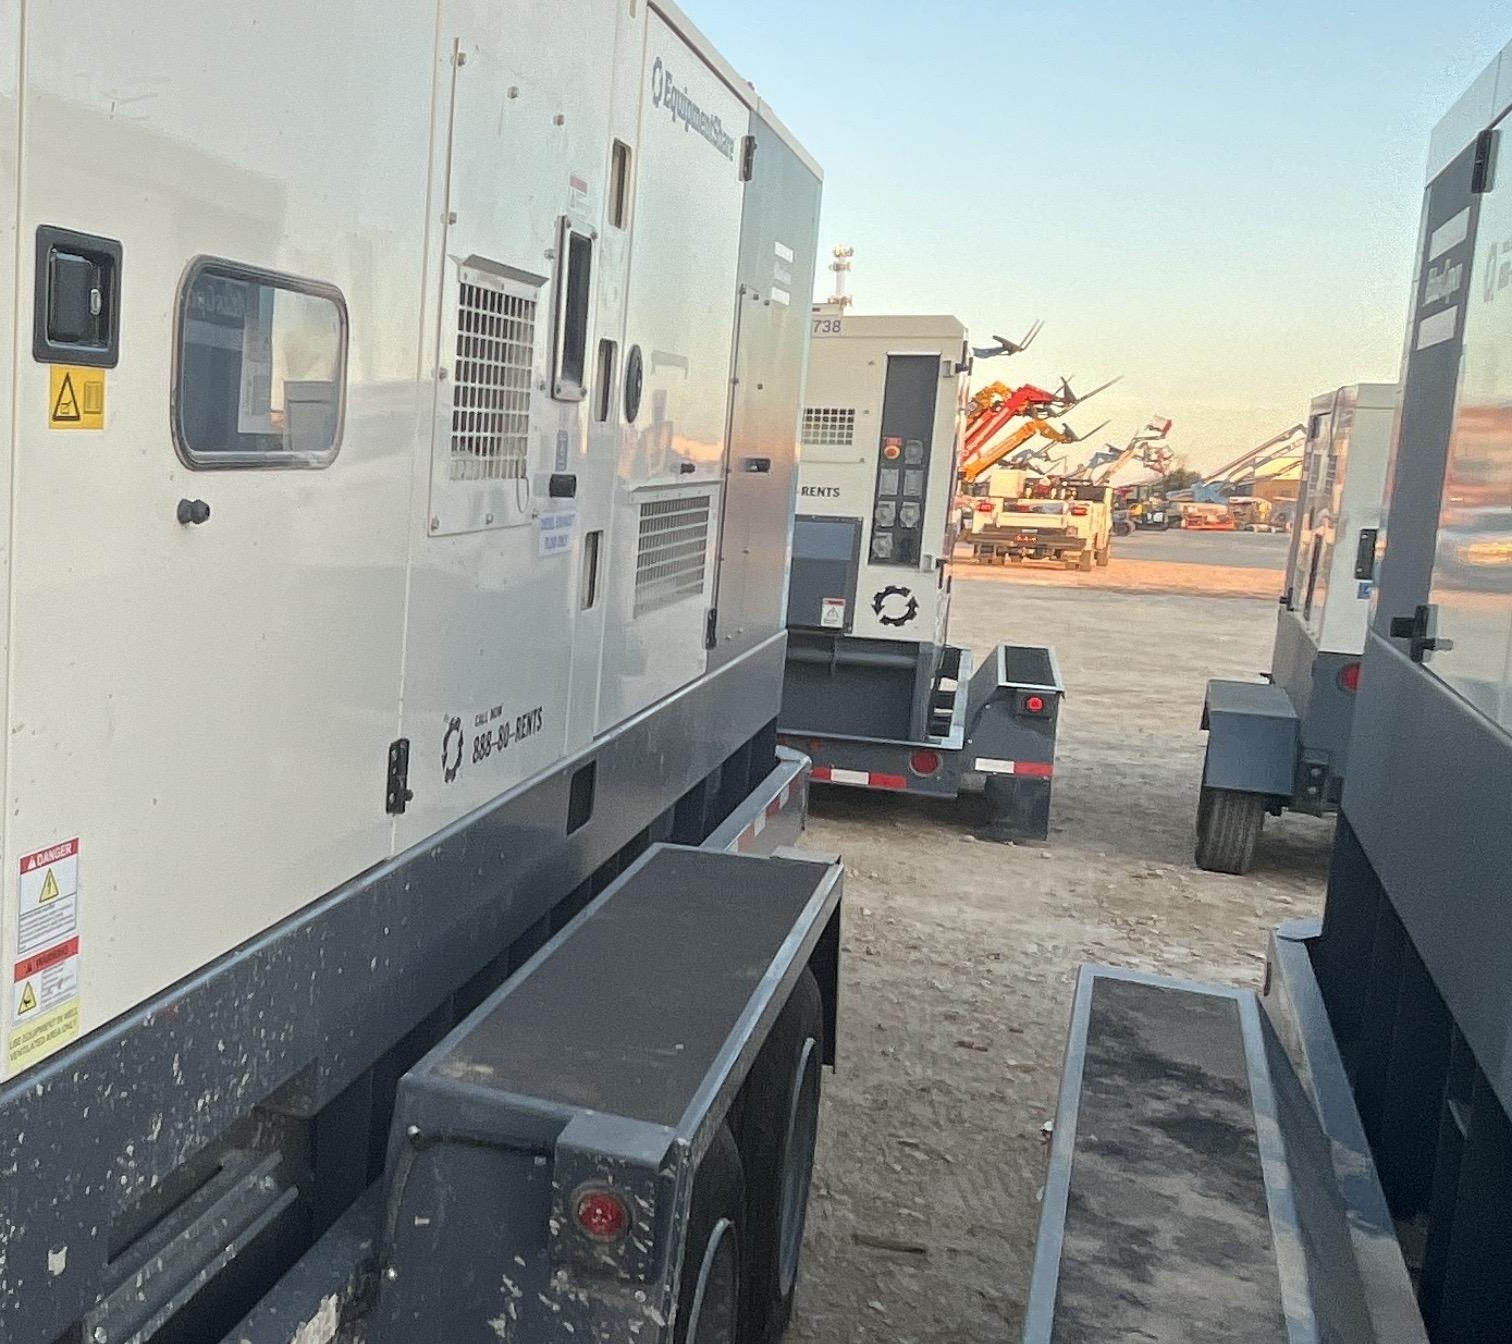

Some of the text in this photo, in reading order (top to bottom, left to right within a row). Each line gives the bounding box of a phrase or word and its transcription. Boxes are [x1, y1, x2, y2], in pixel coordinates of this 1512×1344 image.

[813, 319, 841, 333] 738
[472, 705, 543, 764] 888-80-RENTS
[37, 842, 73, 867] DANGER
